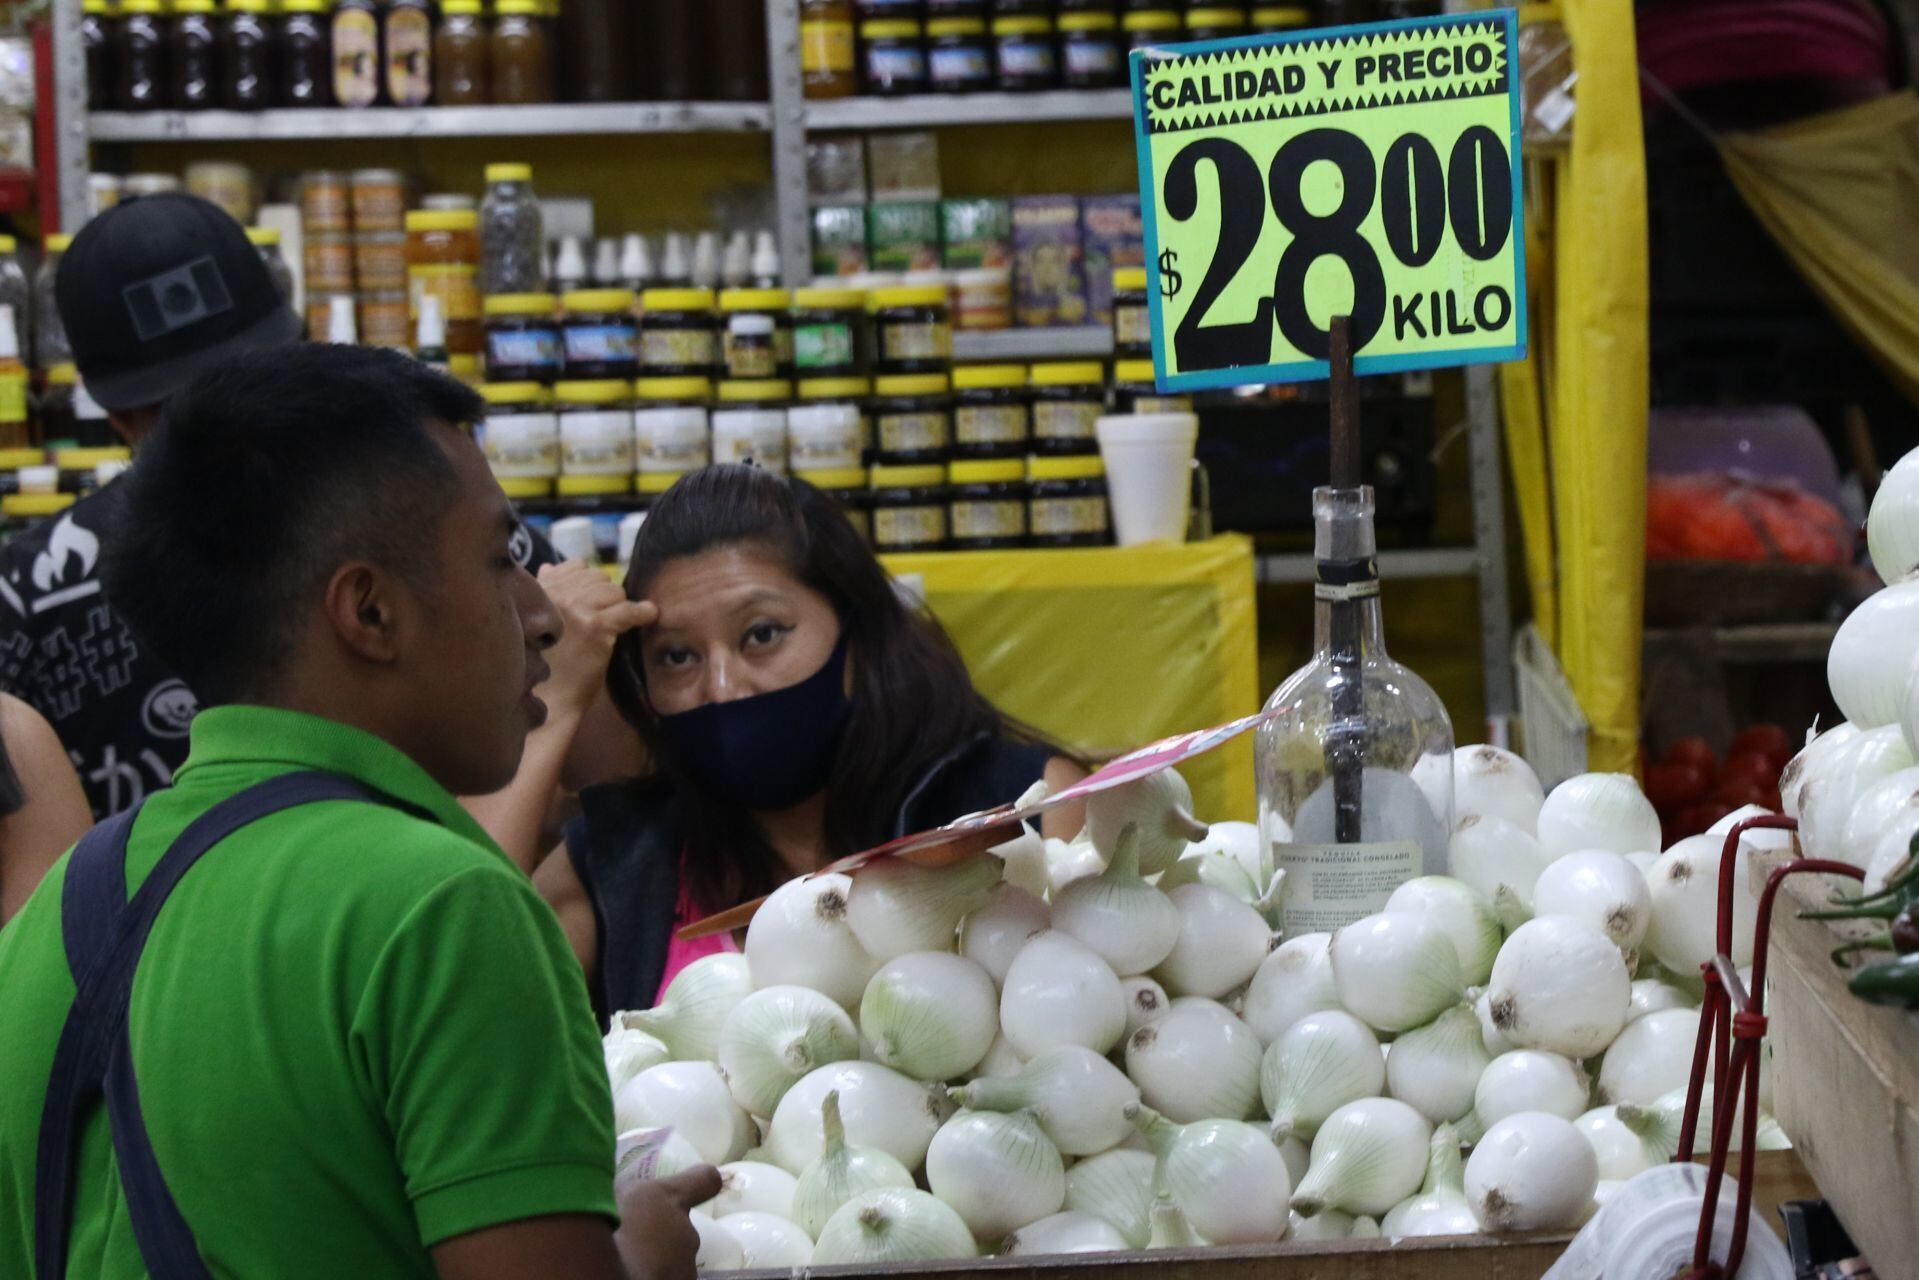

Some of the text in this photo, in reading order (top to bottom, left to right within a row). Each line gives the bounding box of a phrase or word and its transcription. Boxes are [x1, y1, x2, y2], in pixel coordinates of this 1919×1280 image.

[1152, 43, 1492, 110] CALIDAD Y PRECIO
[1157, 247, 1183, 302] $
[1393, 285, 1512, 341] KILO
